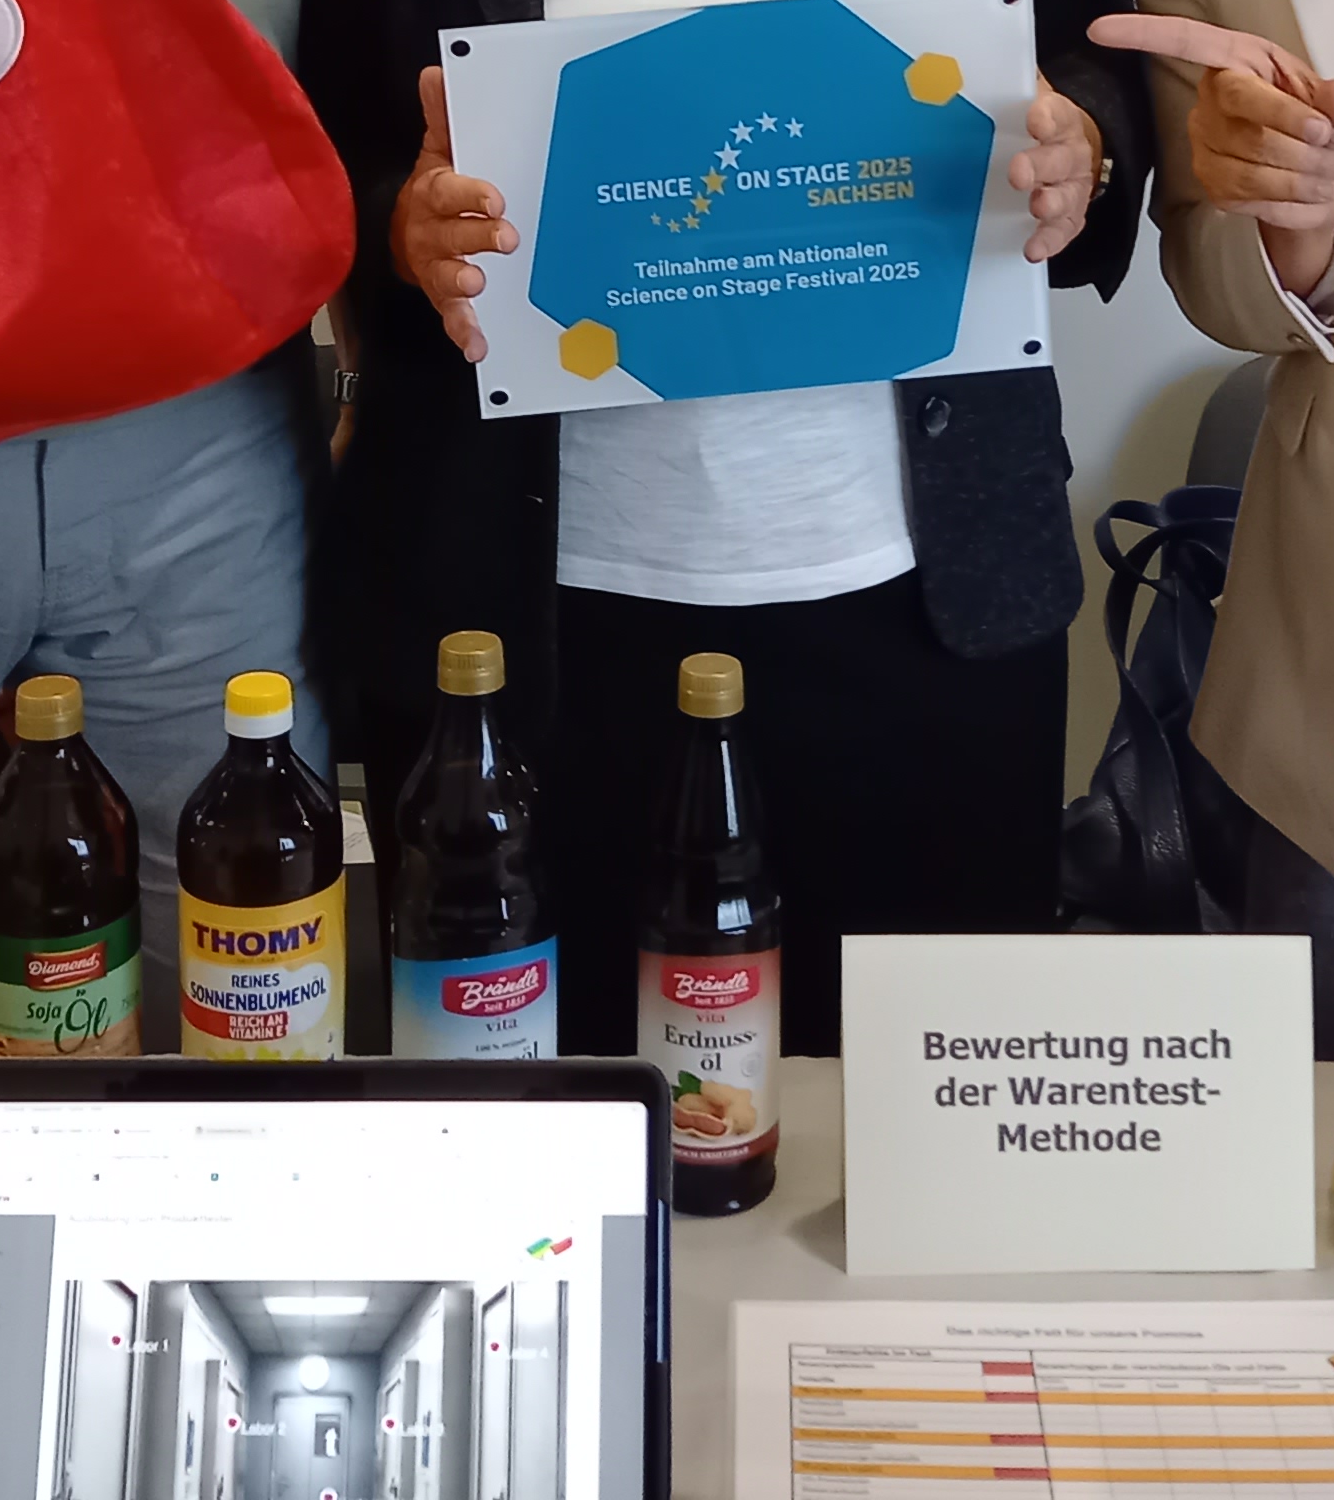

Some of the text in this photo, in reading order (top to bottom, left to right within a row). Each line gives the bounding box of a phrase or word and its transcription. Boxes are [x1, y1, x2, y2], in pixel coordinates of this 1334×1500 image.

[596, 157, 912, 204] SCIENCE ON STAGE 2025
[806, 180, 914, 208] SACHSEN
[633, 242, 888, 279] Teilnahme am Nationalen
[606, 261, 920, 308] Science on Stage Festival 2025
[191, 916, 322, 957] THOMY
[28, 953, 100, 979] Diamond
[190, 976, 327, 1012] SONNENBLUMENÖL
[231, 973, 280, 989] REINES
[458, 965, 540, 1010] Brändle
[673, 971, 750, 998] Brändle
[27, 1002, 62, 1024] Soja
[229, 1013, 283, 1027] REICH AN
[486, 1018, 517, 1032] vita
[229, 1026, 274, 1039] VITAMIN
[665, 1024, 756, 1048] Erdnuss-
[700, 1052, 721, 1071] öl
[923, 1029, 1232, 1066] Bewertung nach
[934, 1076, 1221, 1106] der Warentest-
[997, 1121, 1161, 1152] Methode
